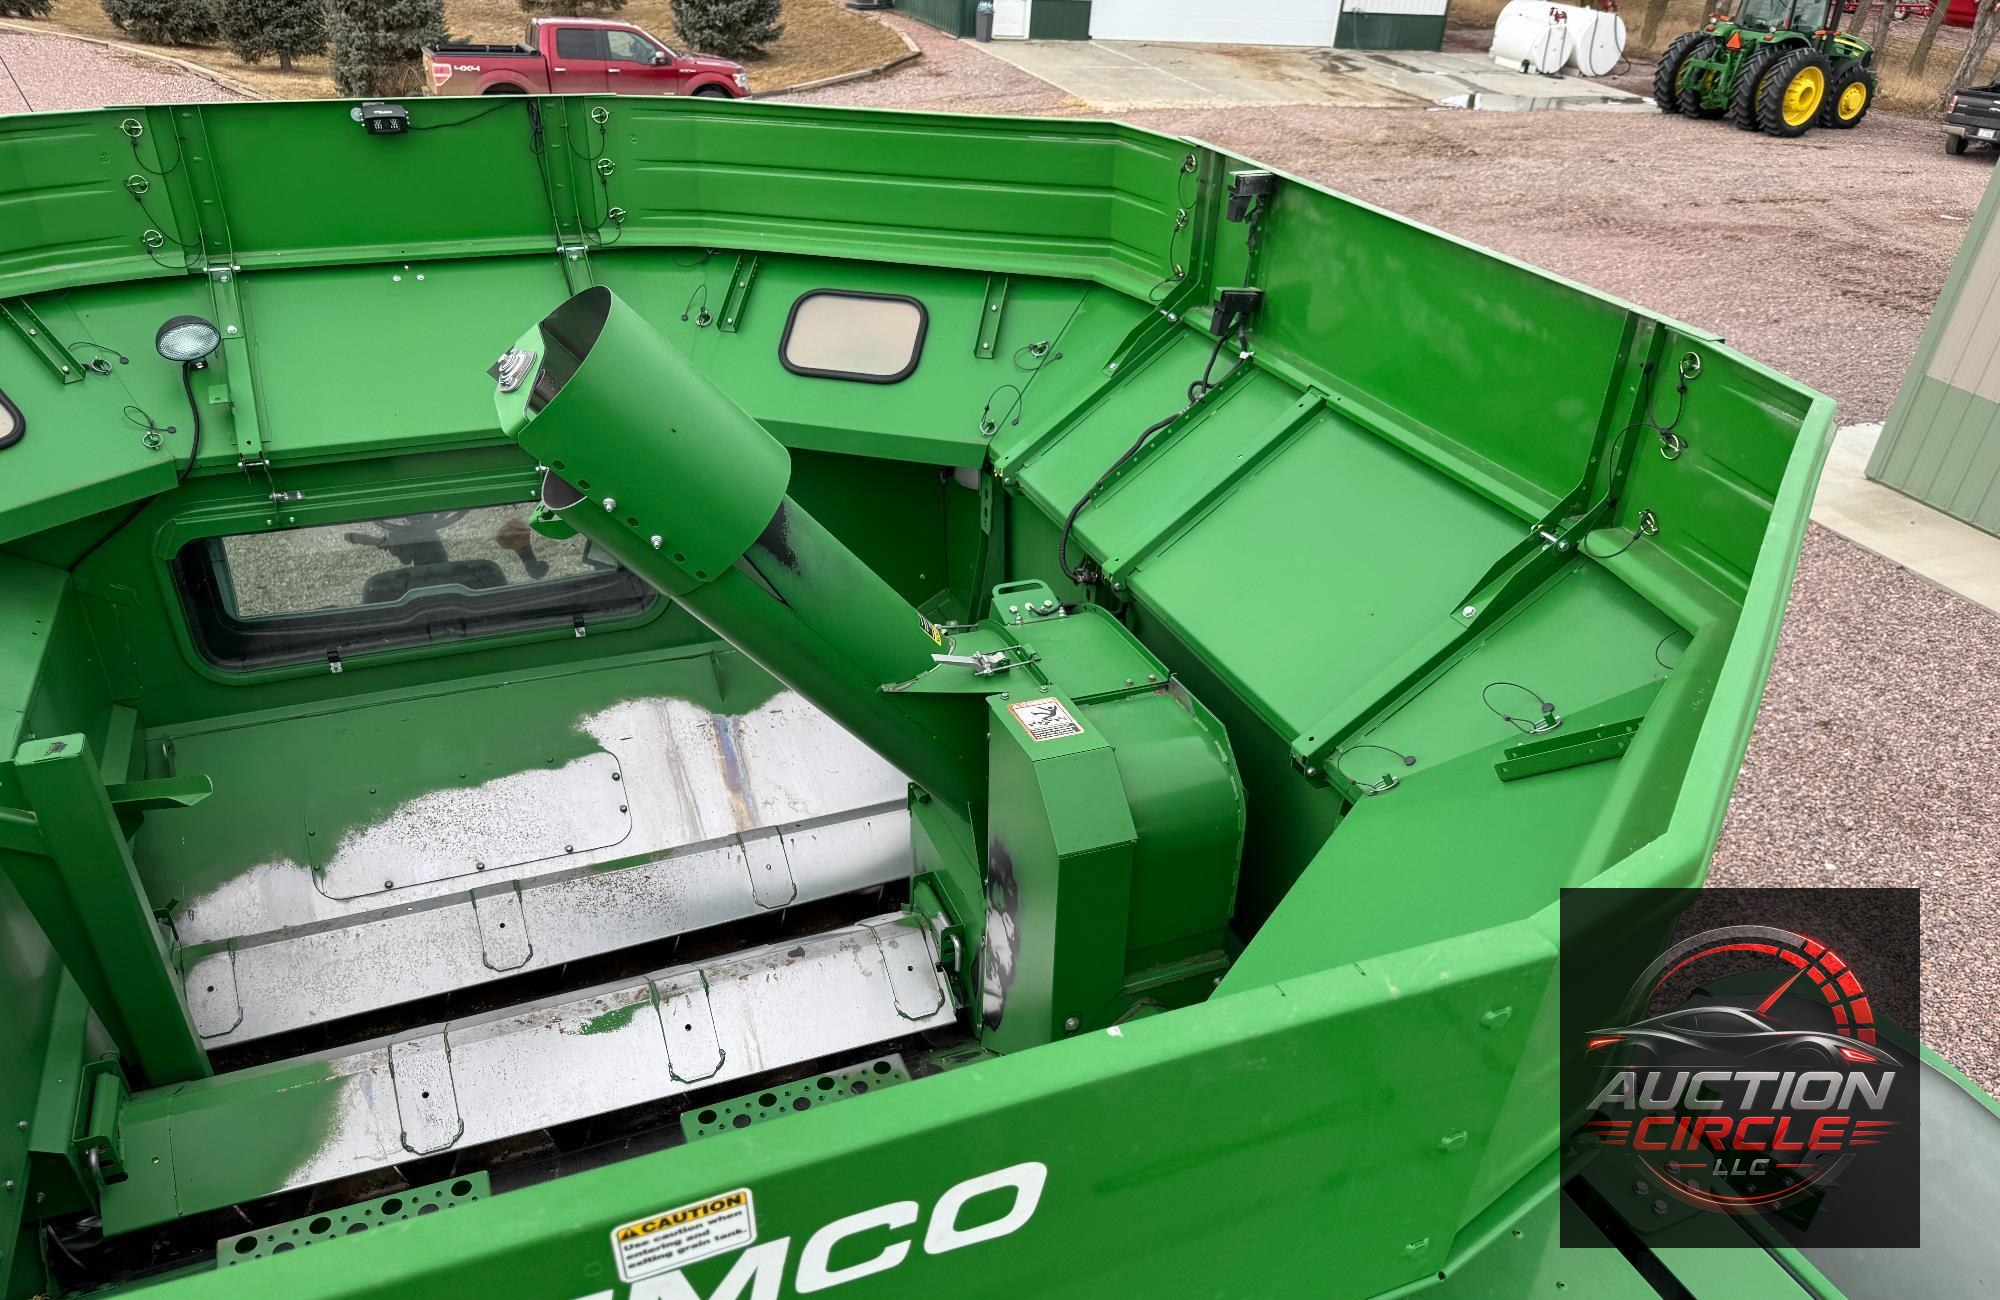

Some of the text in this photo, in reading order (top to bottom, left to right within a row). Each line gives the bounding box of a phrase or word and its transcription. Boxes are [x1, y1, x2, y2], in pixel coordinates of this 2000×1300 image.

[570, 1161, 1048, 1300] MCO
[624, 1210, 743, 1251] Use caution when
[642, 1194, 742, 1233] CAUTION
[626, 1229, 710, 1260] entering and
[628, 1227, 748, 1269] exiting grain tank.
